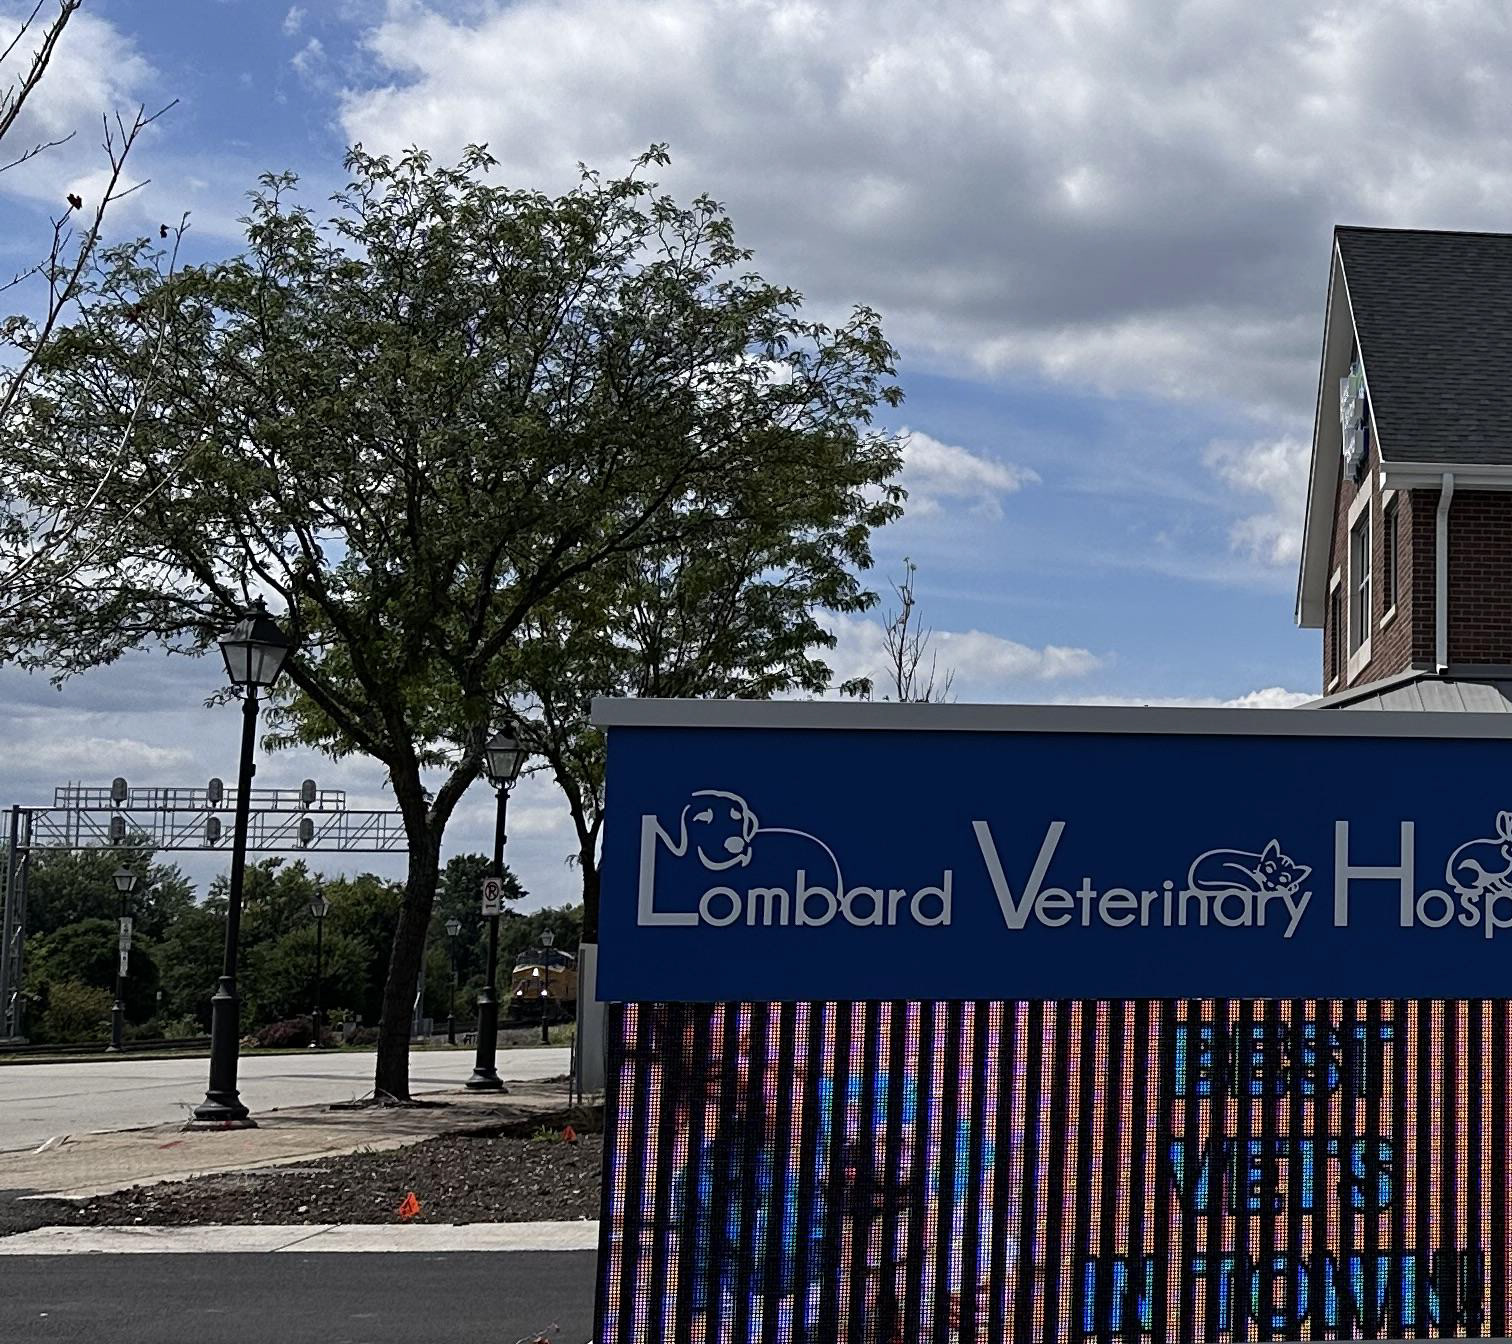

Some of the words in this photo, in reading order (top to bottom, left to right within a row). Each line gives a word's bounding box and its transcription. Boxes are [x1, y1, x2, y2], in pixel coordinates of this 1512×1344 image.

[637, 814, 953, 927] Lombard
[971, 820, 1313, 939] Veterinary
[1171, 1024, 1396, 1098] BEST
[1168, 1139, 1396, 1211] VETS
[1082, 1256, 1157, 1334] IN
